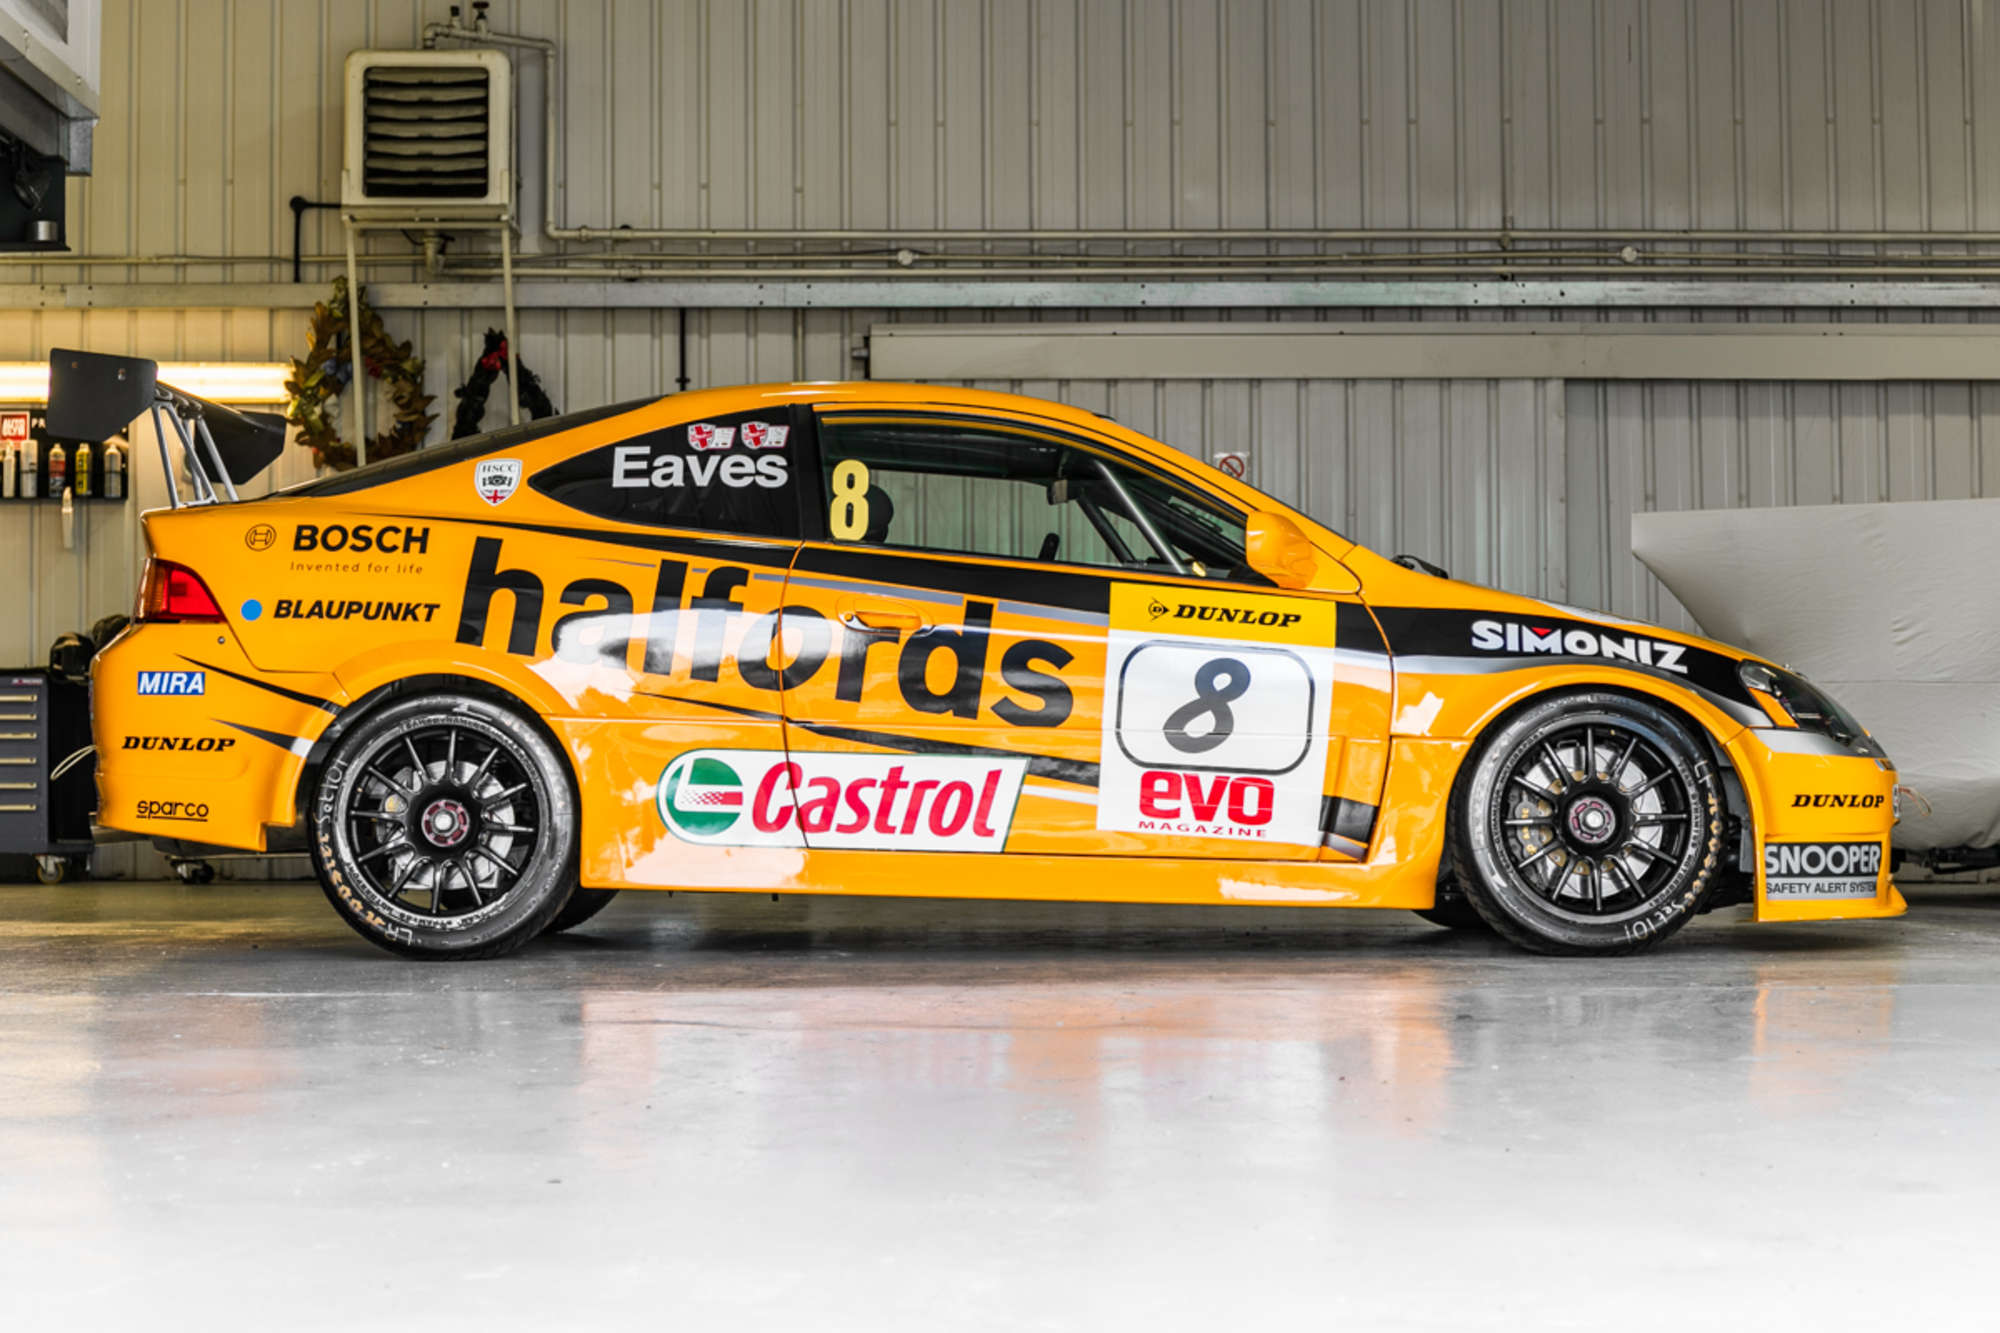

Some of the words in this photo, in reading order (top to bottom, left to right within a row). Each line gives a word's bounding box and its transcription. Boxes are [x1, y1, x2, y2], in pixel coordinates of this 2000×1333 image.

[612, 446, 788, 488] Eaves
[830, 459, 869, 541] 8
[293, 525, 430, 554] BOSCH
[290, 561, 360, 572] Invented
[368, 563, 389, 573] for
[397, 564, 423, 574] life
[274, 599, 440, 622] BLAUPUNKT
[1173, 604, 1302, 627] DUNLOP
[456, 536, 1074, 728] halfords
[1471, 620, 1688, 674] SIMONIZ
[139, 672, 204, 694] MIRA
[1162, 657, 1251, 754] 8
[121, 736, 235, 752] DUNLOP
[137, 800, 209, 819] sparco
[751, 761, 1003, 837] Castrol
[1139, 770, 1275, 826] evo
[1791, 794, 1885, 808] DUNLOP
[1138, 821, 1267, 838] MAGAZINE
[1765, 844, 1881, 875] SNOOPER
[1766, 882, 1811, 894] SAFETY
[1814, 882, 1847, 893] ALERT
